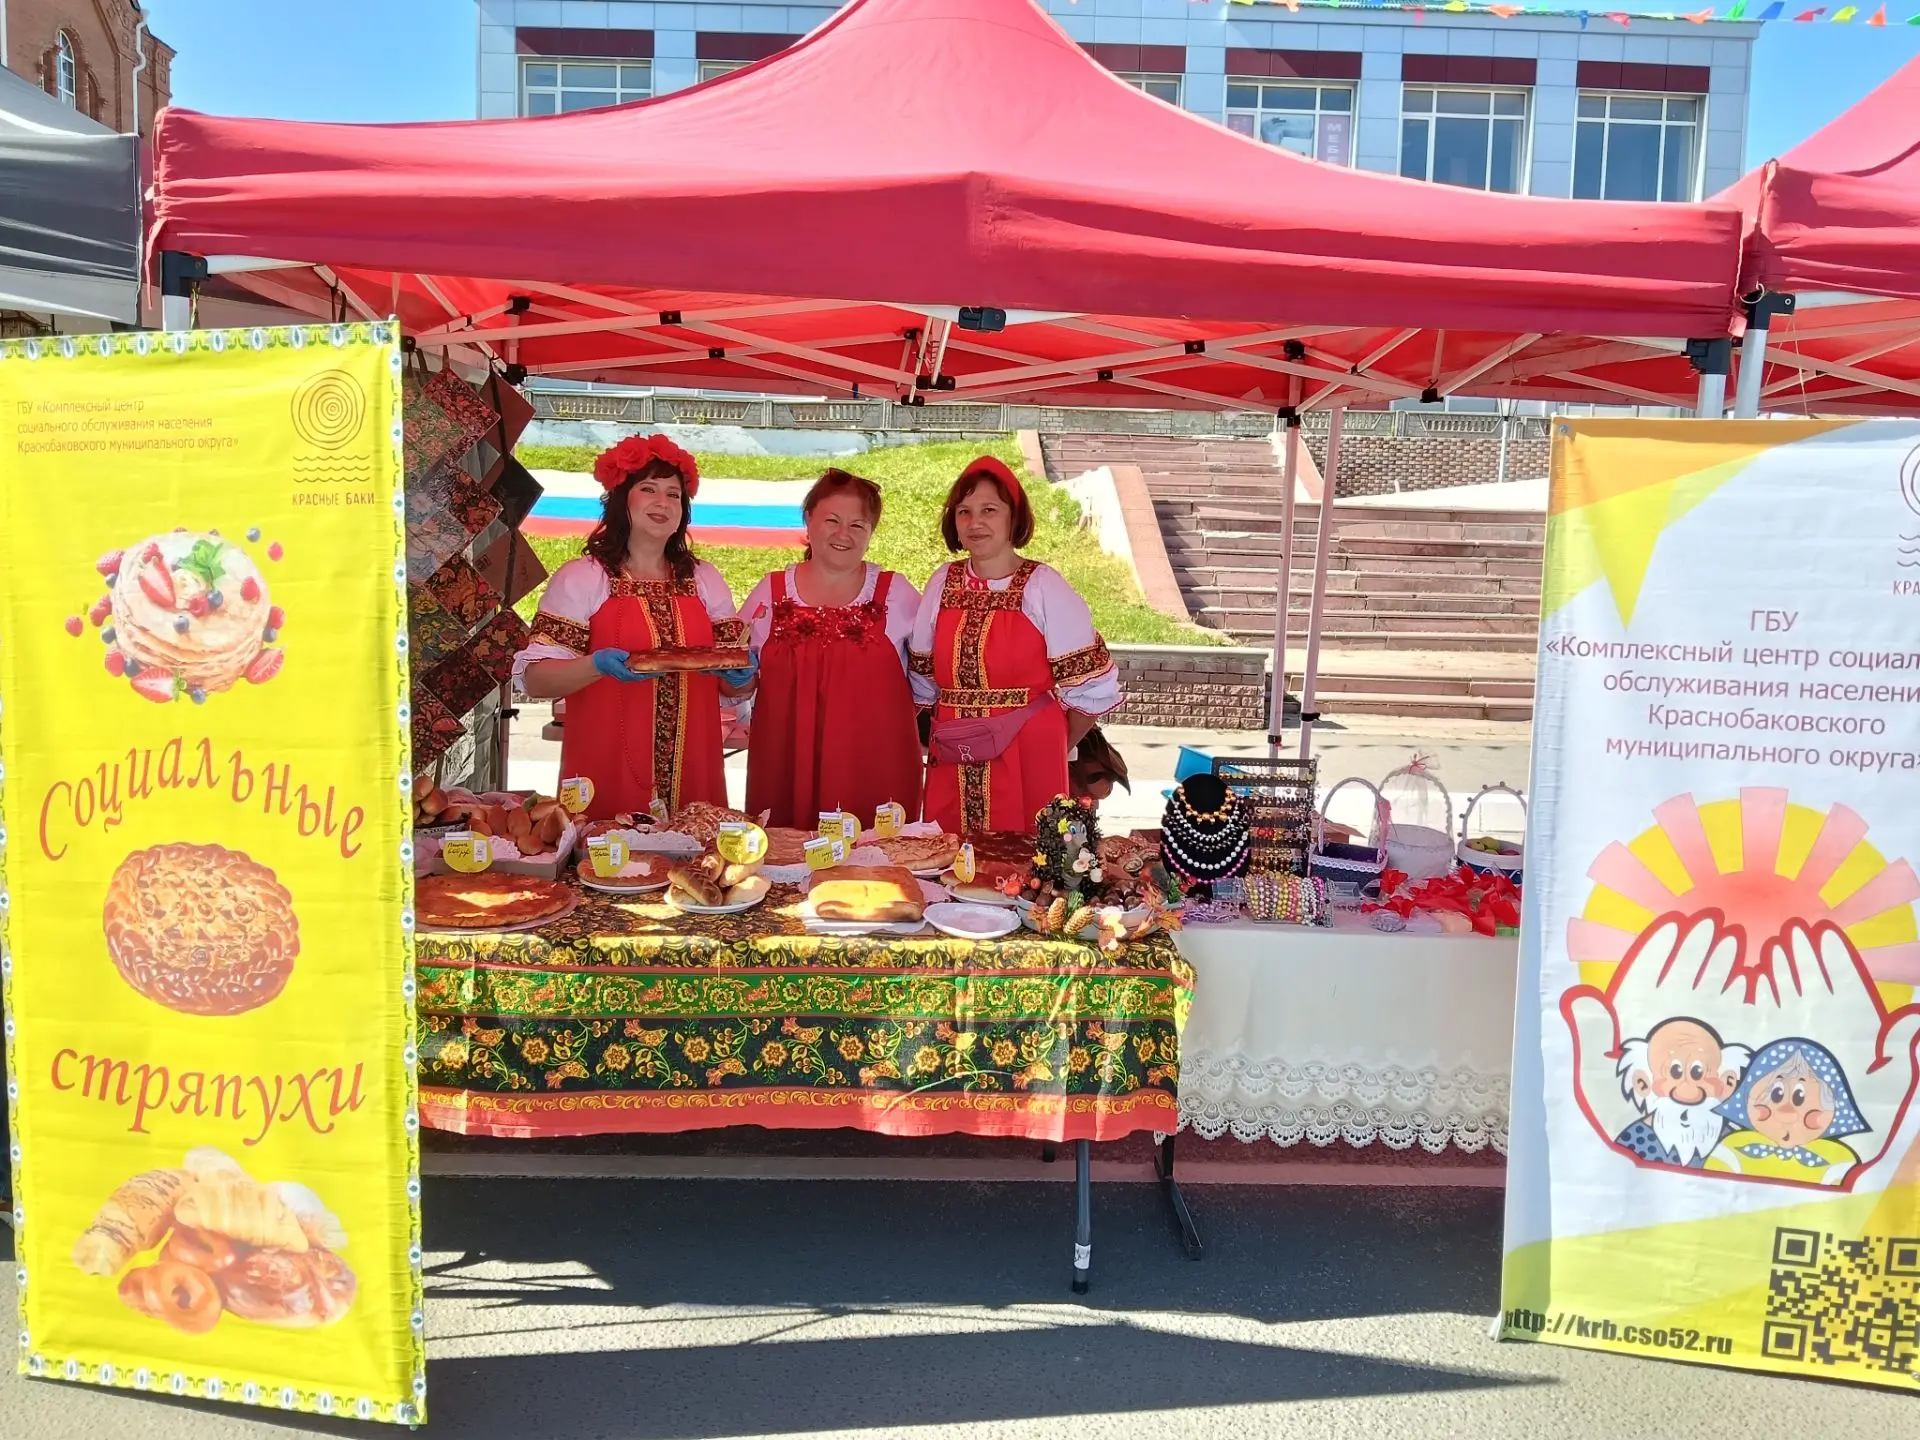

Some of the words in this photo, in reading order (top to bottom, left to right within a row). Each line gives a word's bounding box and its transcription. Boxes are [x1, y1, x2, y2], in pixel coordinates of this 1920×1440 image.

[17, 401, 33, 414] ГБУ
[36, 398, 111, 413] «Комплексный
[113, 400, 145, 414] центр
[17, 421, 79, 435] социального
[81, 419, 155, 433] обслуживания
[158, 417, 213, 430] населения
[17, 439, 106, 455] Краснобаковского
[109, 438, 195, 452] муниципального
[197, 435, 239, 449] округа»
[292, 493, 340, 506] КРАСНЫЕ
[345, 492, 375, 505] БАКИ
[1750, 610, 1799, 632] ГБУ
[1546, 636, 1733, 663] «Комплексный
[1743, 647, 1819, 671] центр
[1603, 670, 1789, 699] обслуживания
[1648, 703, 1886, 735] Краснобаковского
[1606, 738, 1820, 765] муниципального
[39, 736, 364, 860] Социальные
[51, 1048, 366, 1146] стряпухи
